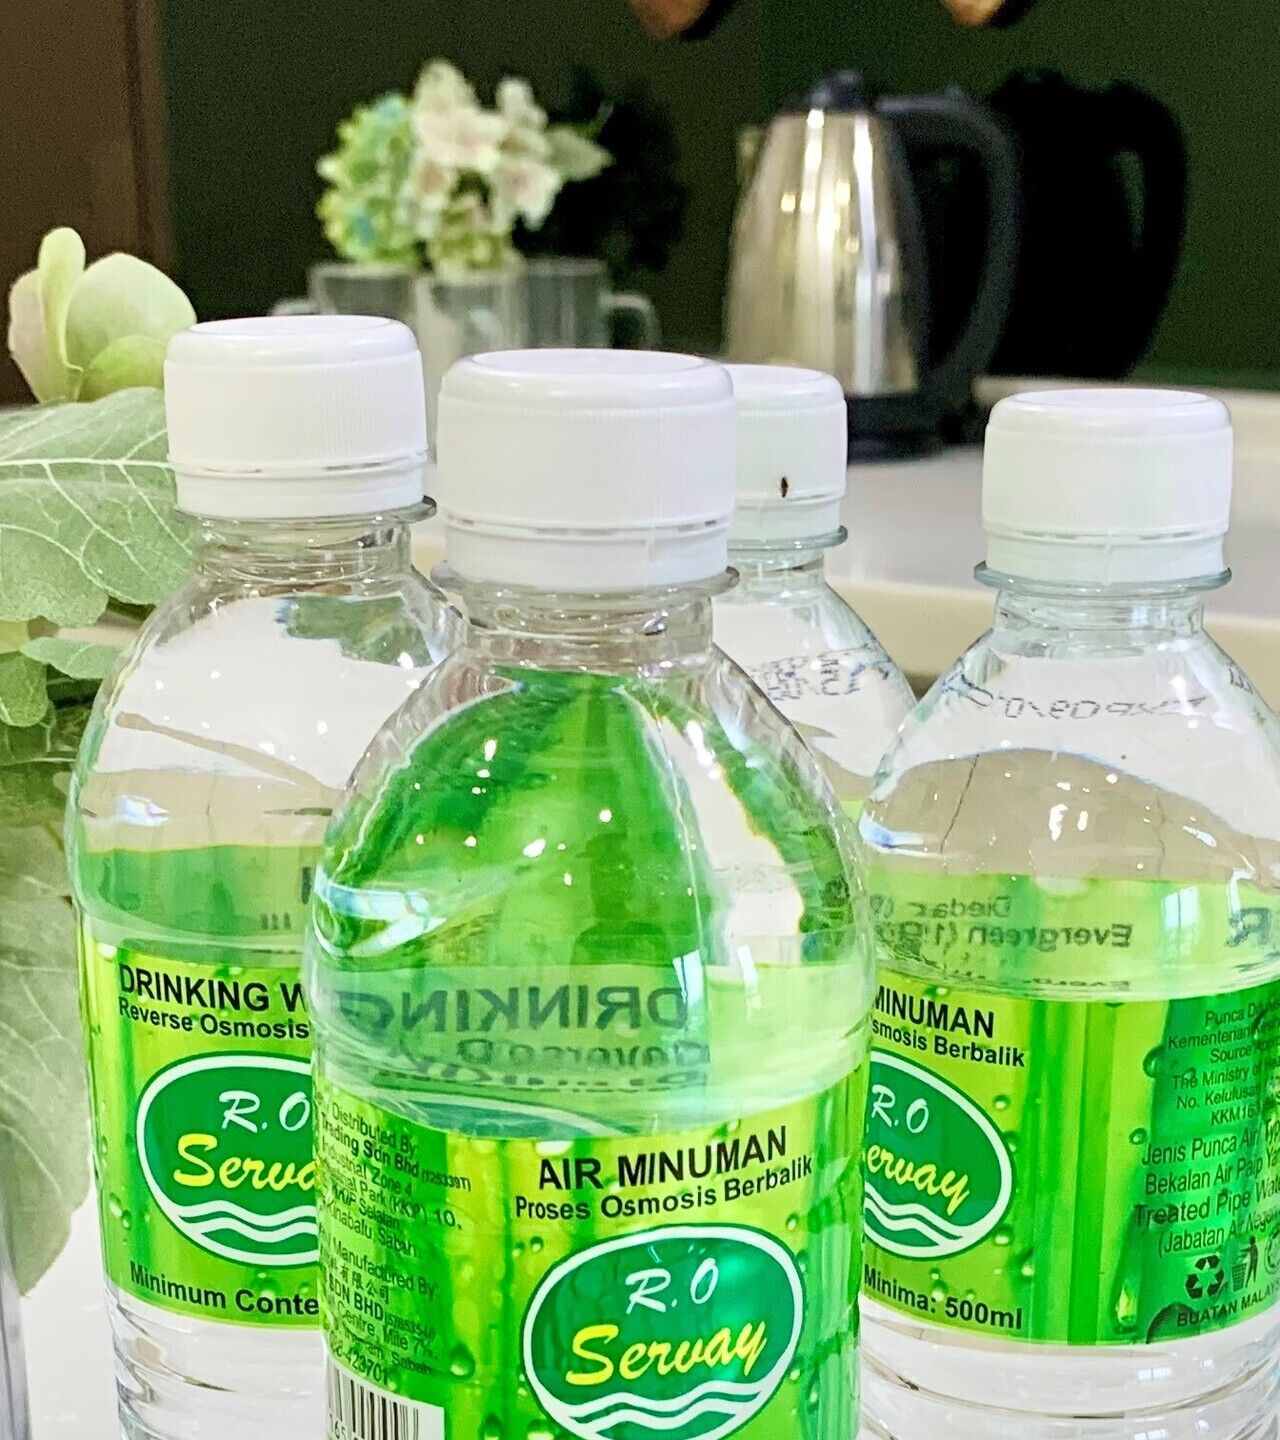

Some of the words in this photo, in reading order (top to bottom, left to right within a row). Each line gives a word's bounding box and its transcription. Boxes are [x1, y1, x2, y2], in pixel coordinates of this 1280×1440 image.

[119, 964, 270, 1012] DRINKING
[118, 997, 192, 1032] Reverse
[200, 1016, 310, 1039] Osmosis
[873, 985, 994, 1039] MINUMAN
[1205, 1009, 1245, 1028] Punca
[872, 1018, 928, 1051] smosis
[934, 1034, 1025, 1067] Berbalik
[1173, 1071, 1199, 1090] The
[1202, 1065, 1250, 1088] Ministry
[174, 1134, 318, 1191] Serva
[363, 1139, 392, 1166] Sdn
[394, 1154, 420, 1176] Bhd
[539, 1157, 604, 1191] AIR
[618, 1125, 787, 1188] MINUMAN
[1141, 1142, 1187, 1166] Jenis
[1191, 1135, 1238, 1161] Punca
[516, 1195, 590, 1221] Proses
[600, 1187, 717, 1218] Osmosis
[724, 1154, 813, 1203] Berbalik
[867, 1144, 970, 1216] ervay
[1144, 1169, 1211, 1196] Bekalan
[1213, 1162, 1234, 1186] Air
[1132, 1201, 1211, 1227] Treated
[1216, 1187, 1251, 1217] Pipe
[1158, 1226, 1225, 1259] (Jabatan
[130, 1260, 227, 1310] Minimum
[235, 1288, 320, 1316] Conte
[354, 1292, 384, 1321] BHD
[864, 1263, 936, 1314] Minima:
[944, 1296, 1023, 1330] 500ml
[1176, 1301, 1239, 1328] BUATAN
[565, 1320, 768, 1387] Servay
